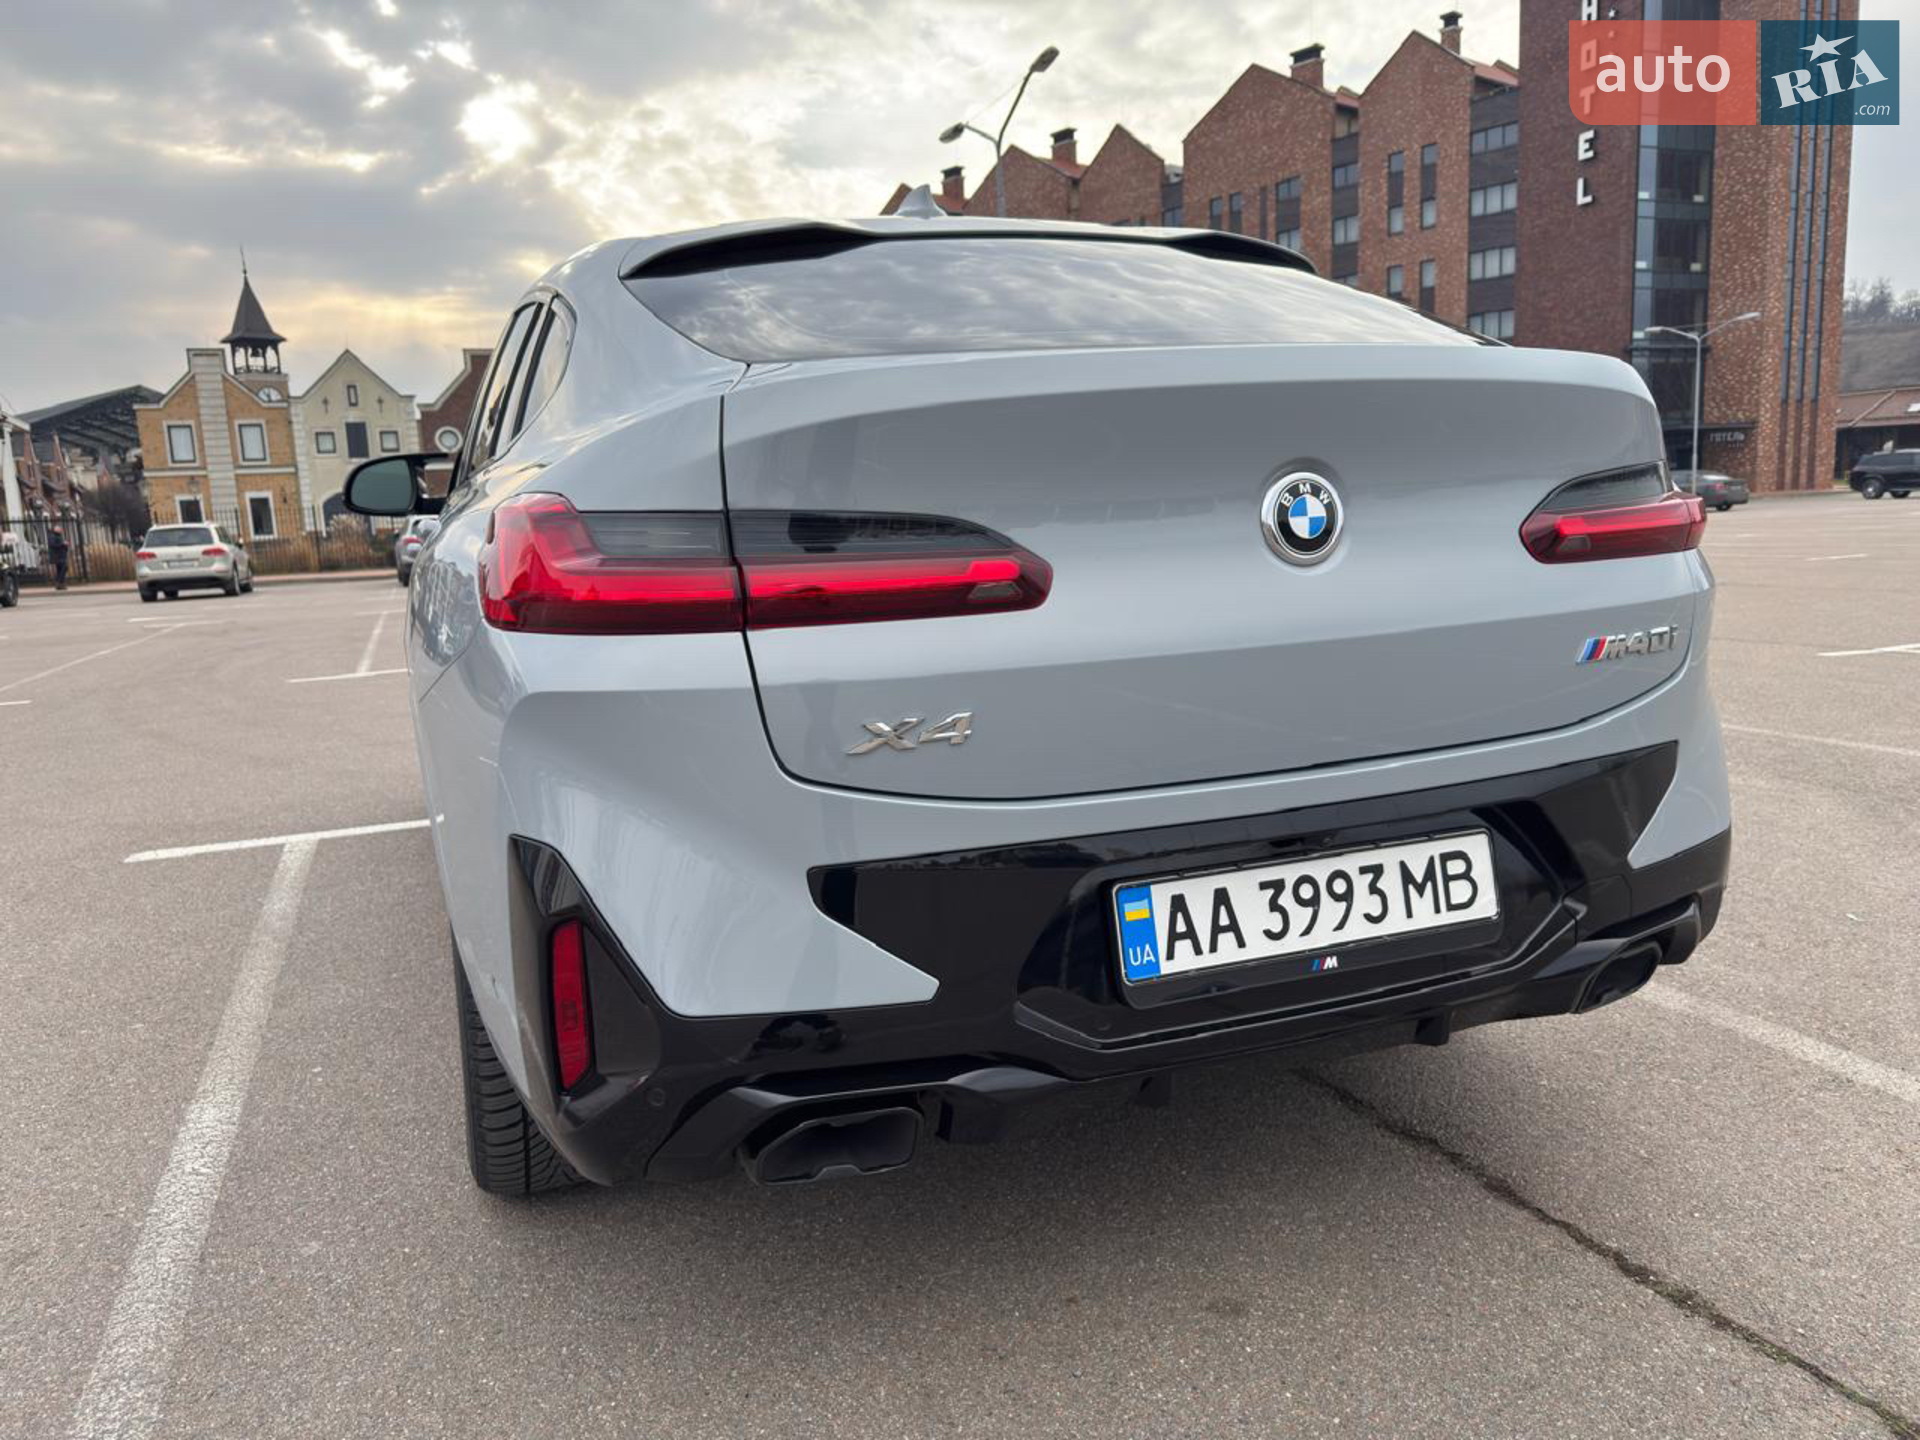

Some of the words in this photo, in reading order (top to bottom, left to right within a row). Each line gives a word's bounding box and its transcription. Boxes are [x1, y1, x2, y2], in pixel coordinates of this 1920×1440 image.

[1576, 0, 1598, 206] HOTEL
[1280, 482, 1331, 507] BMW
[846, 711, 973, 756] X4
[1165, 886, 1247, 961] AA
[1258, 862, 1389, 942] 3993
[1399, 850, 1479, 919] MB
[1128, 941, 1156, 967] UA
